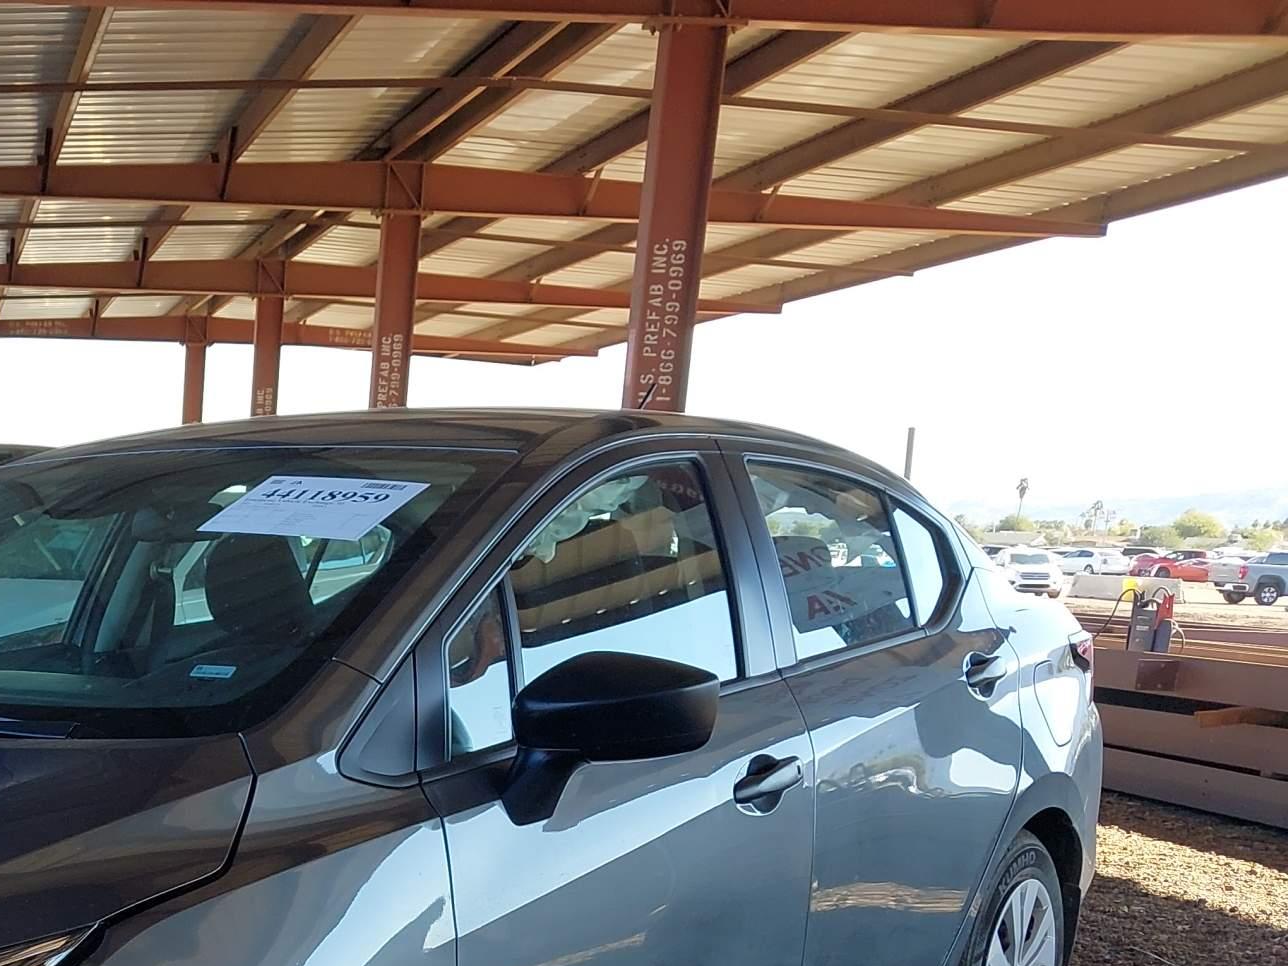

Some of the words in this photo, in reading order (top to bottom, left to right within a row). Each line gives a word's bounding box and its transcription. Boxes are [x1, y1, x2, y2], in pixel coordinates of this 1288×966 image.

[651, 237, 670, 273] INC.
[643, 283, 664, 357] PREFAB
[262, 488, 391, 504] 44118959
[998, 851, 1037, 896] KUMHO
